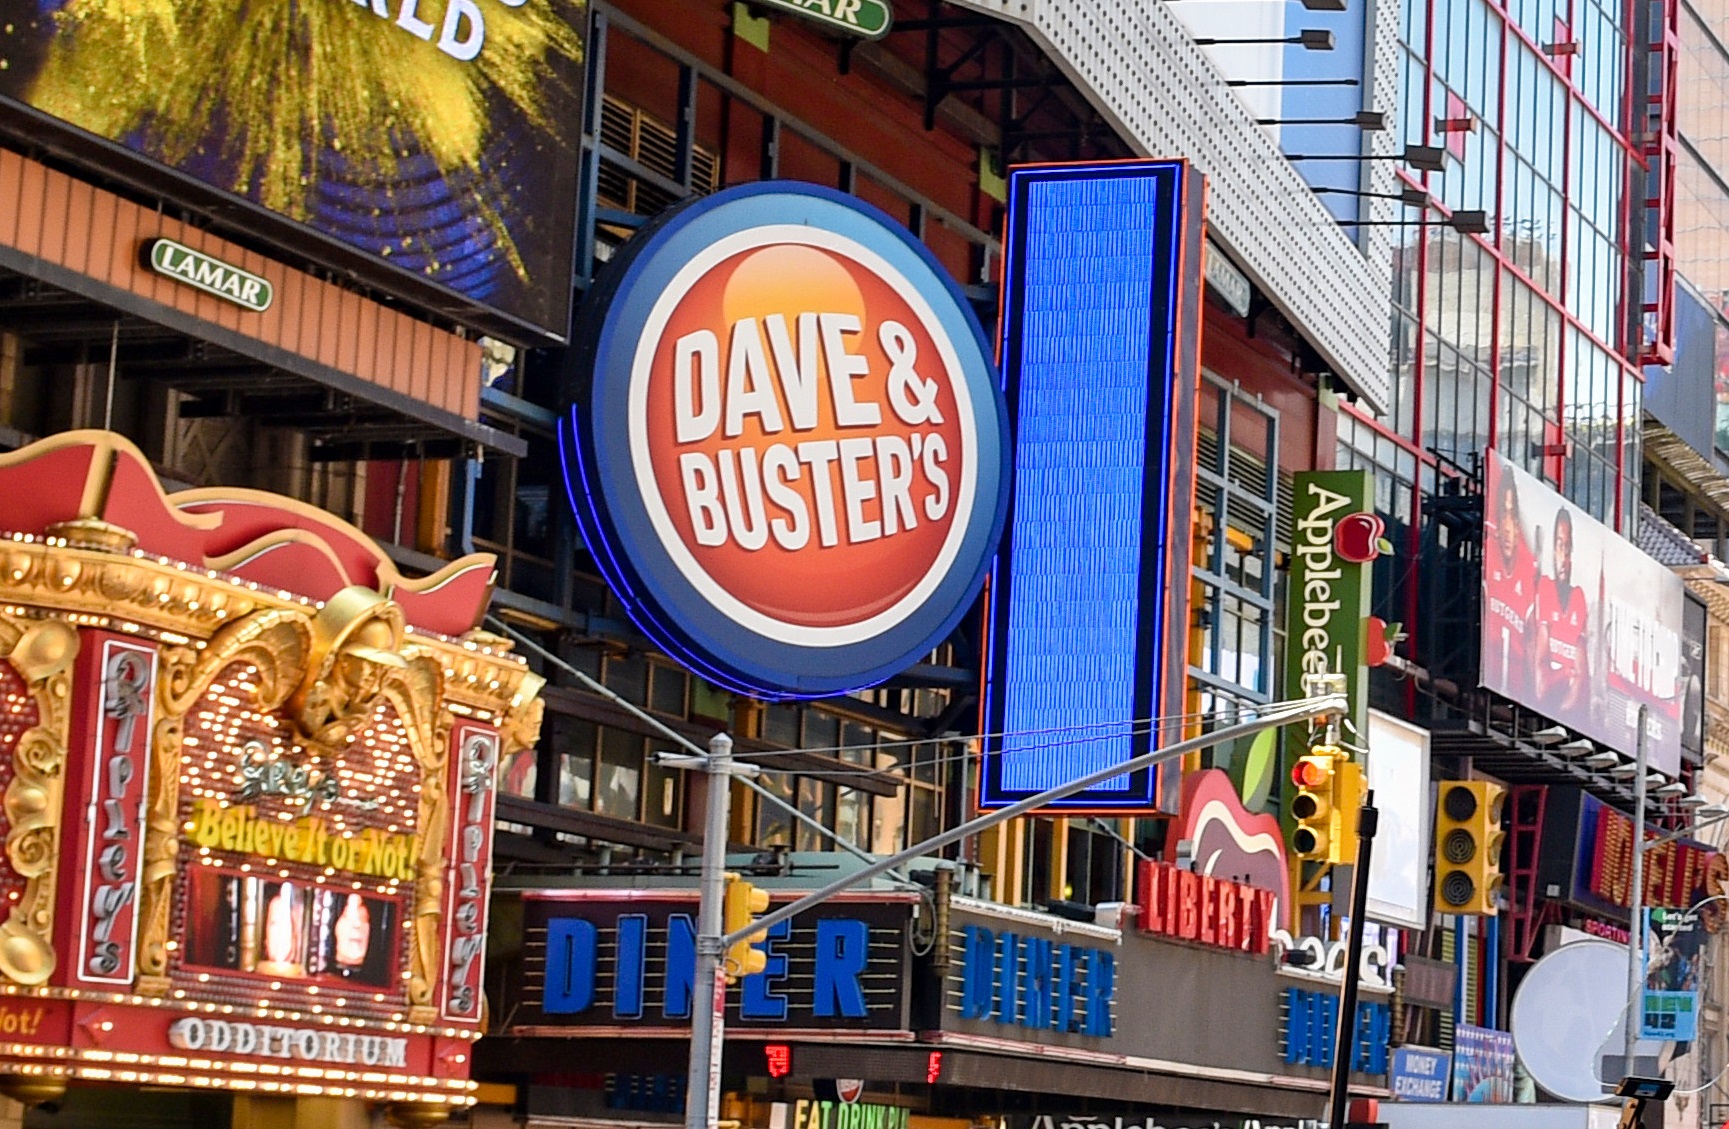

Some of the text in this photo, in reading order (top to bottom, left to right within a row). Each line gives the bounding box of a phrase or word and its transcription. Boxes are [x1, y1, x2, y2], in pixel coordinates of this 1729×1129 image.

[162, 246, 261, 304] LAMAR
[675, 312, 945, 443] DAVE &
[679, 432, 950, 551] BUSTER'S
[1296, 482, 1352, 693] Applebee
[197, 802, 420, 882] Believe It or Not!
[1139, 859, 1276, 954] LIBERTY
[960, 924, 1114, 1038] DINER
[170, 1017, 408, 1067] ODDITORIUM
[1405, 1053, 1438, 1076] MONEY
[1395, 1075, 1443, 1099] EXCHANGE
